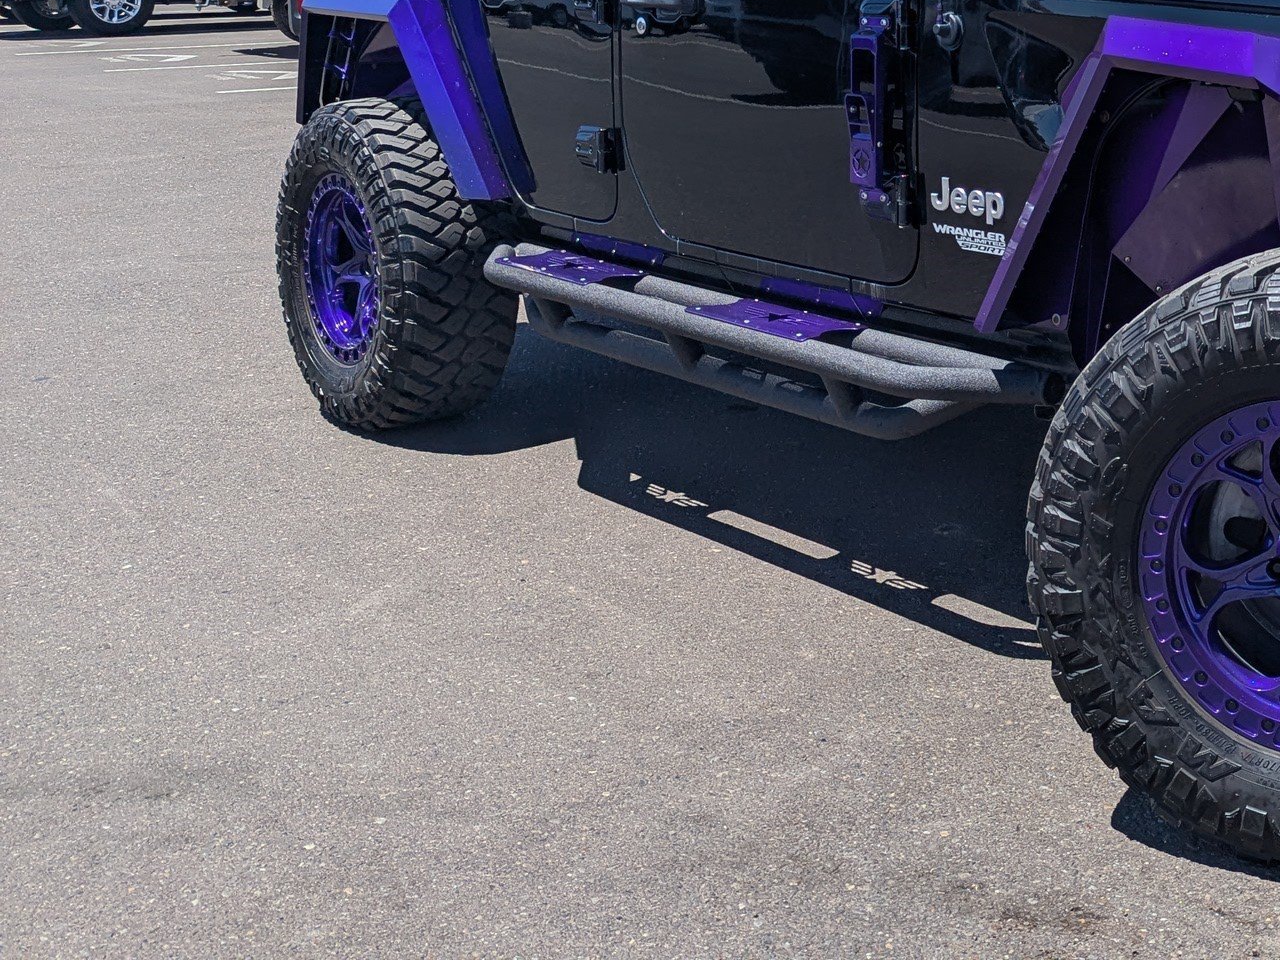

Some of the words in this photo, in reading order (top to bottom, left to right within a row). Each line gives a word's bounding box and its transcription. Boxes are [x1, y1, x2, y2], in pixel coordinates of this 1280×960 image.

[930, 176, 1004, 225] Jeep
[932, 222, 1005, 242] WRANGLER
[955, 235, 1006, 247] UNLIMITED
[961, 242, 1005, 255] SPORT
